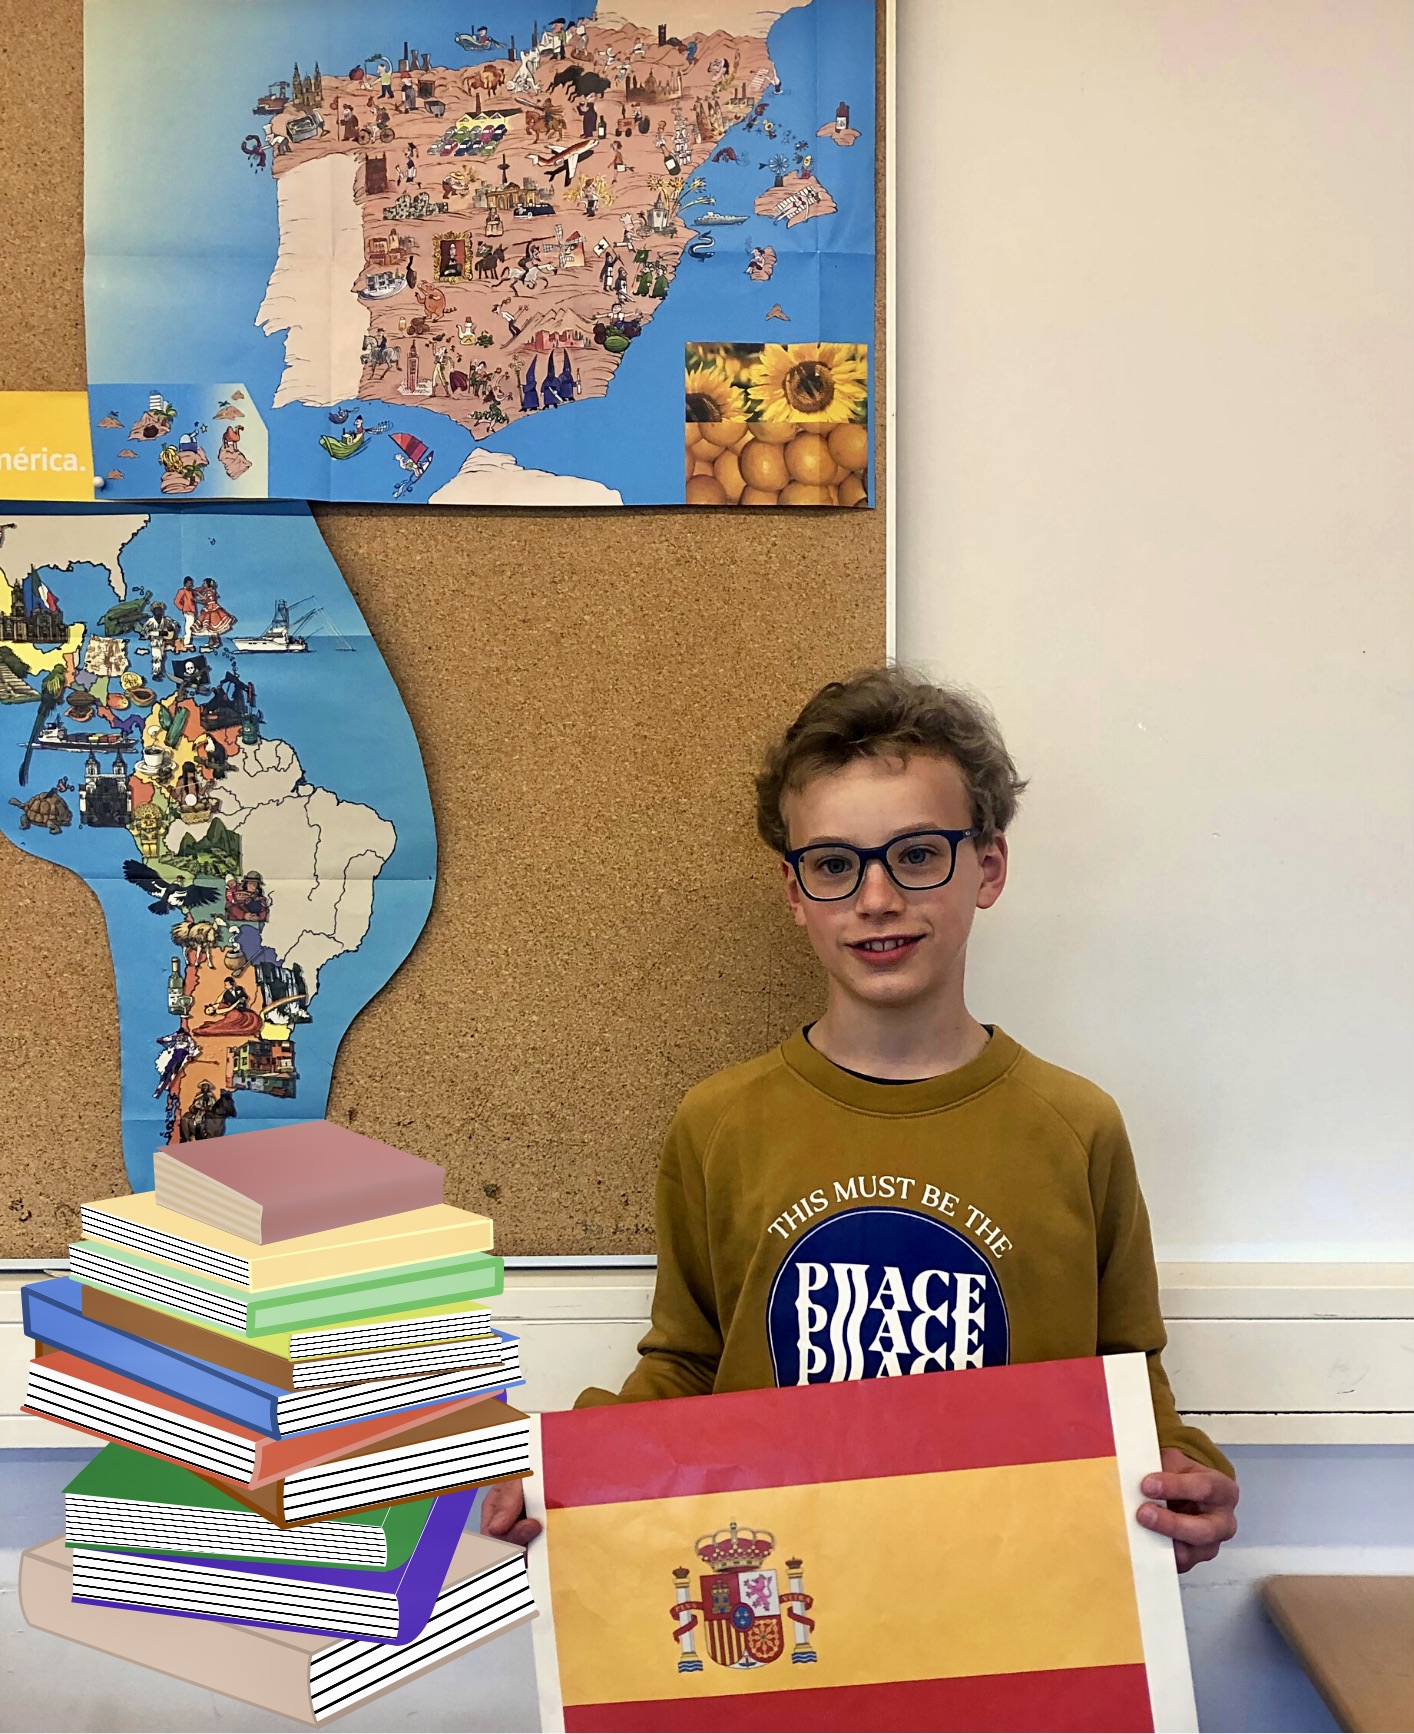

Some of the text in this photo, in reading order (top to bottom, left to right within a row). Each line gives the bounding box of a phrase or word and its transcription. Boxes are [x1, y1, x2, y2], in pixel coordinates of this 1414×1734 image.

[767, 1175, 1013, 1259] THIS MUST BE THE
